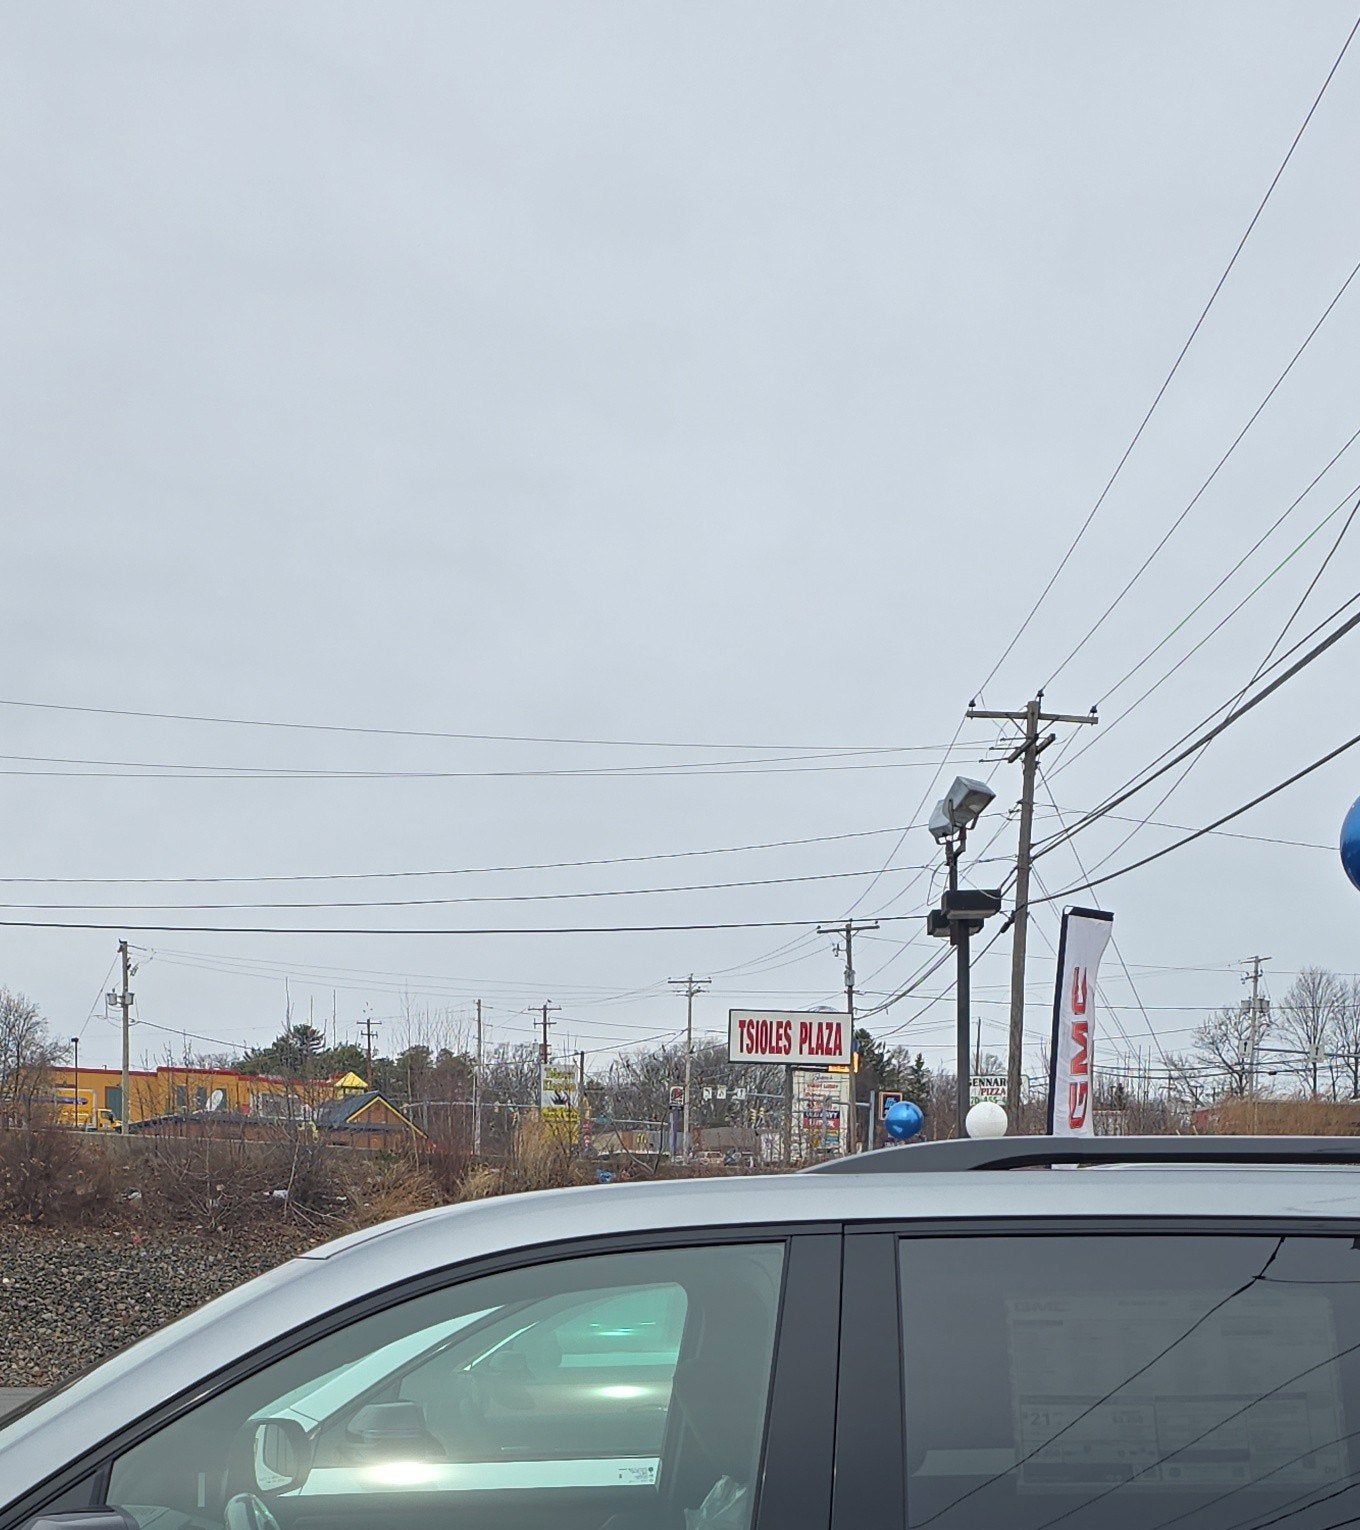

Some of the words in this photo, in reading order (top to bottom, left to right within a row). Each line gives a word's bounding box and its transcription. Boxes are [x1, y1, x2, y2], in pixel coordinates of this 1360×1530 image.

[738, 1018, 792, 1056] TSIOLES
[799, 1021, 843, 1056] PLAZA
[1069, 966, 1089, 1129] GMC
[981, 1087, 1006, 1096] PIZZA
